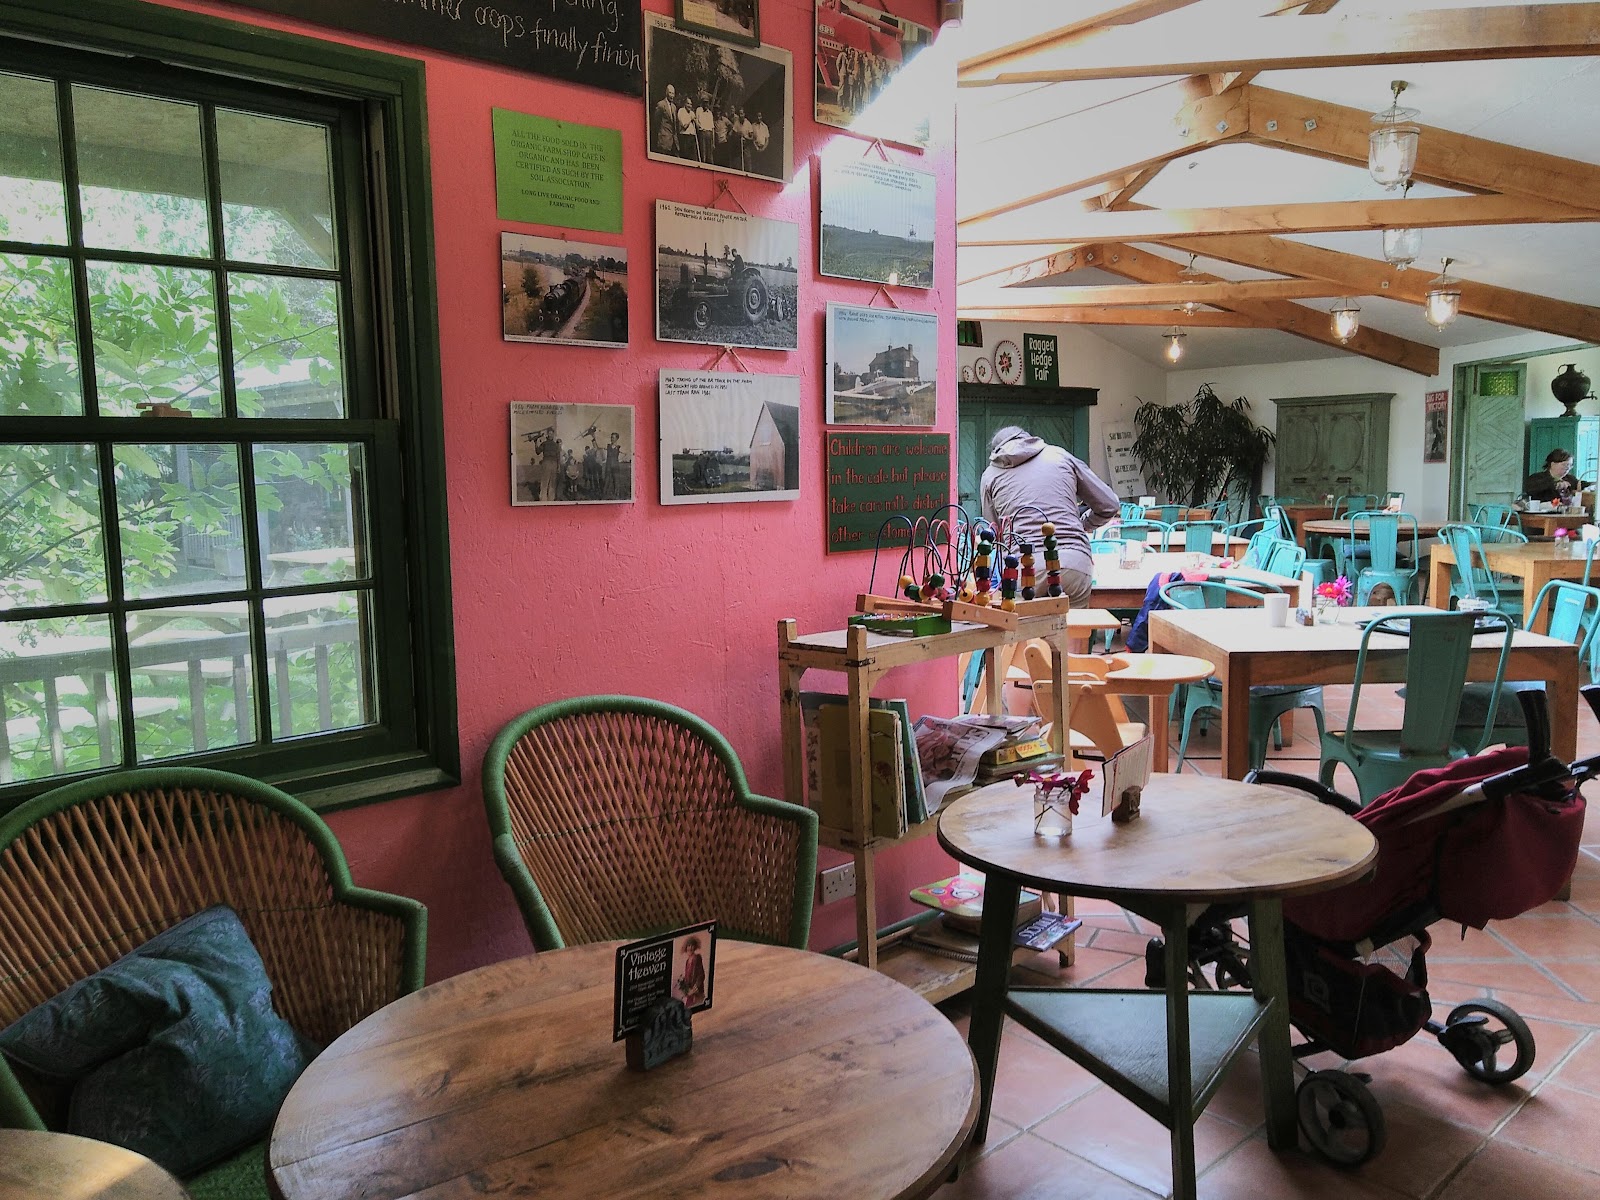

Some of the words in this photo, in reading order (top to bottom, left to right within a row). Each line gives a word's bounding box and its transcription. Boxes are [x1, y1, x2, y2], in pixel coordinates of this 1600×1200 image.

[530, 17, 589, 70] finally
[590, 31, 642, 72] finish
[510, 140, 542, 151] ORGANIC
[543, 146, 561, 155] FARM
[562, 149, 581, 158] SHOP
[599, 154, 606, 162] IS
[512, 130, 525, 139] ALL
[526, 132, 541, 141] THE
[542, 135, 560, 145] FOOD
[561, 139, 579, 148] SOLD
[589, 144, 604, 152] THE
[515, 160, 551, 173] CERTIFIED
[552, 167, 561, 175] AS
[561, 168, 579, 178] SUCH
[590, 173, 604, 181] THE
[518, 151, 550, 163] ORGANIC
[550, 157, 565, 165] AND
[566, 159, 580, 168] HAS
[582, 162, 600, 171] BEEN
[530, 173, 544, 182] SOIL
[521, 189, 537, 197] LONG
[537, 191, 550, 199] LIVE
[550, 193, 574, 202] ORGANIC
[574, 196, 588, 204] FOOD
[1028, 337, 1055, 356] Ragged
[1030, 352, 1053, 369] Hedge
[1034, 367, 1050, 381] Fair
[830, 438, 878, 456] Children
[882, 444, 900, 456] are
[905, 438, 947, 456] welcome
[831, 468, 842, 485] in
[845, 467, 864, 484] the
[890, 466, 909, 483] but
[912, 466, 947, 489] please
[831, 496, 856, 514] take
[859, 501, 882, 513] care
[885, 494, 899, 512] not
[831, 526, 863, 543] other
[630, 947, 667, 967] Vintage
[628, 961, 667, 982] Heaven
